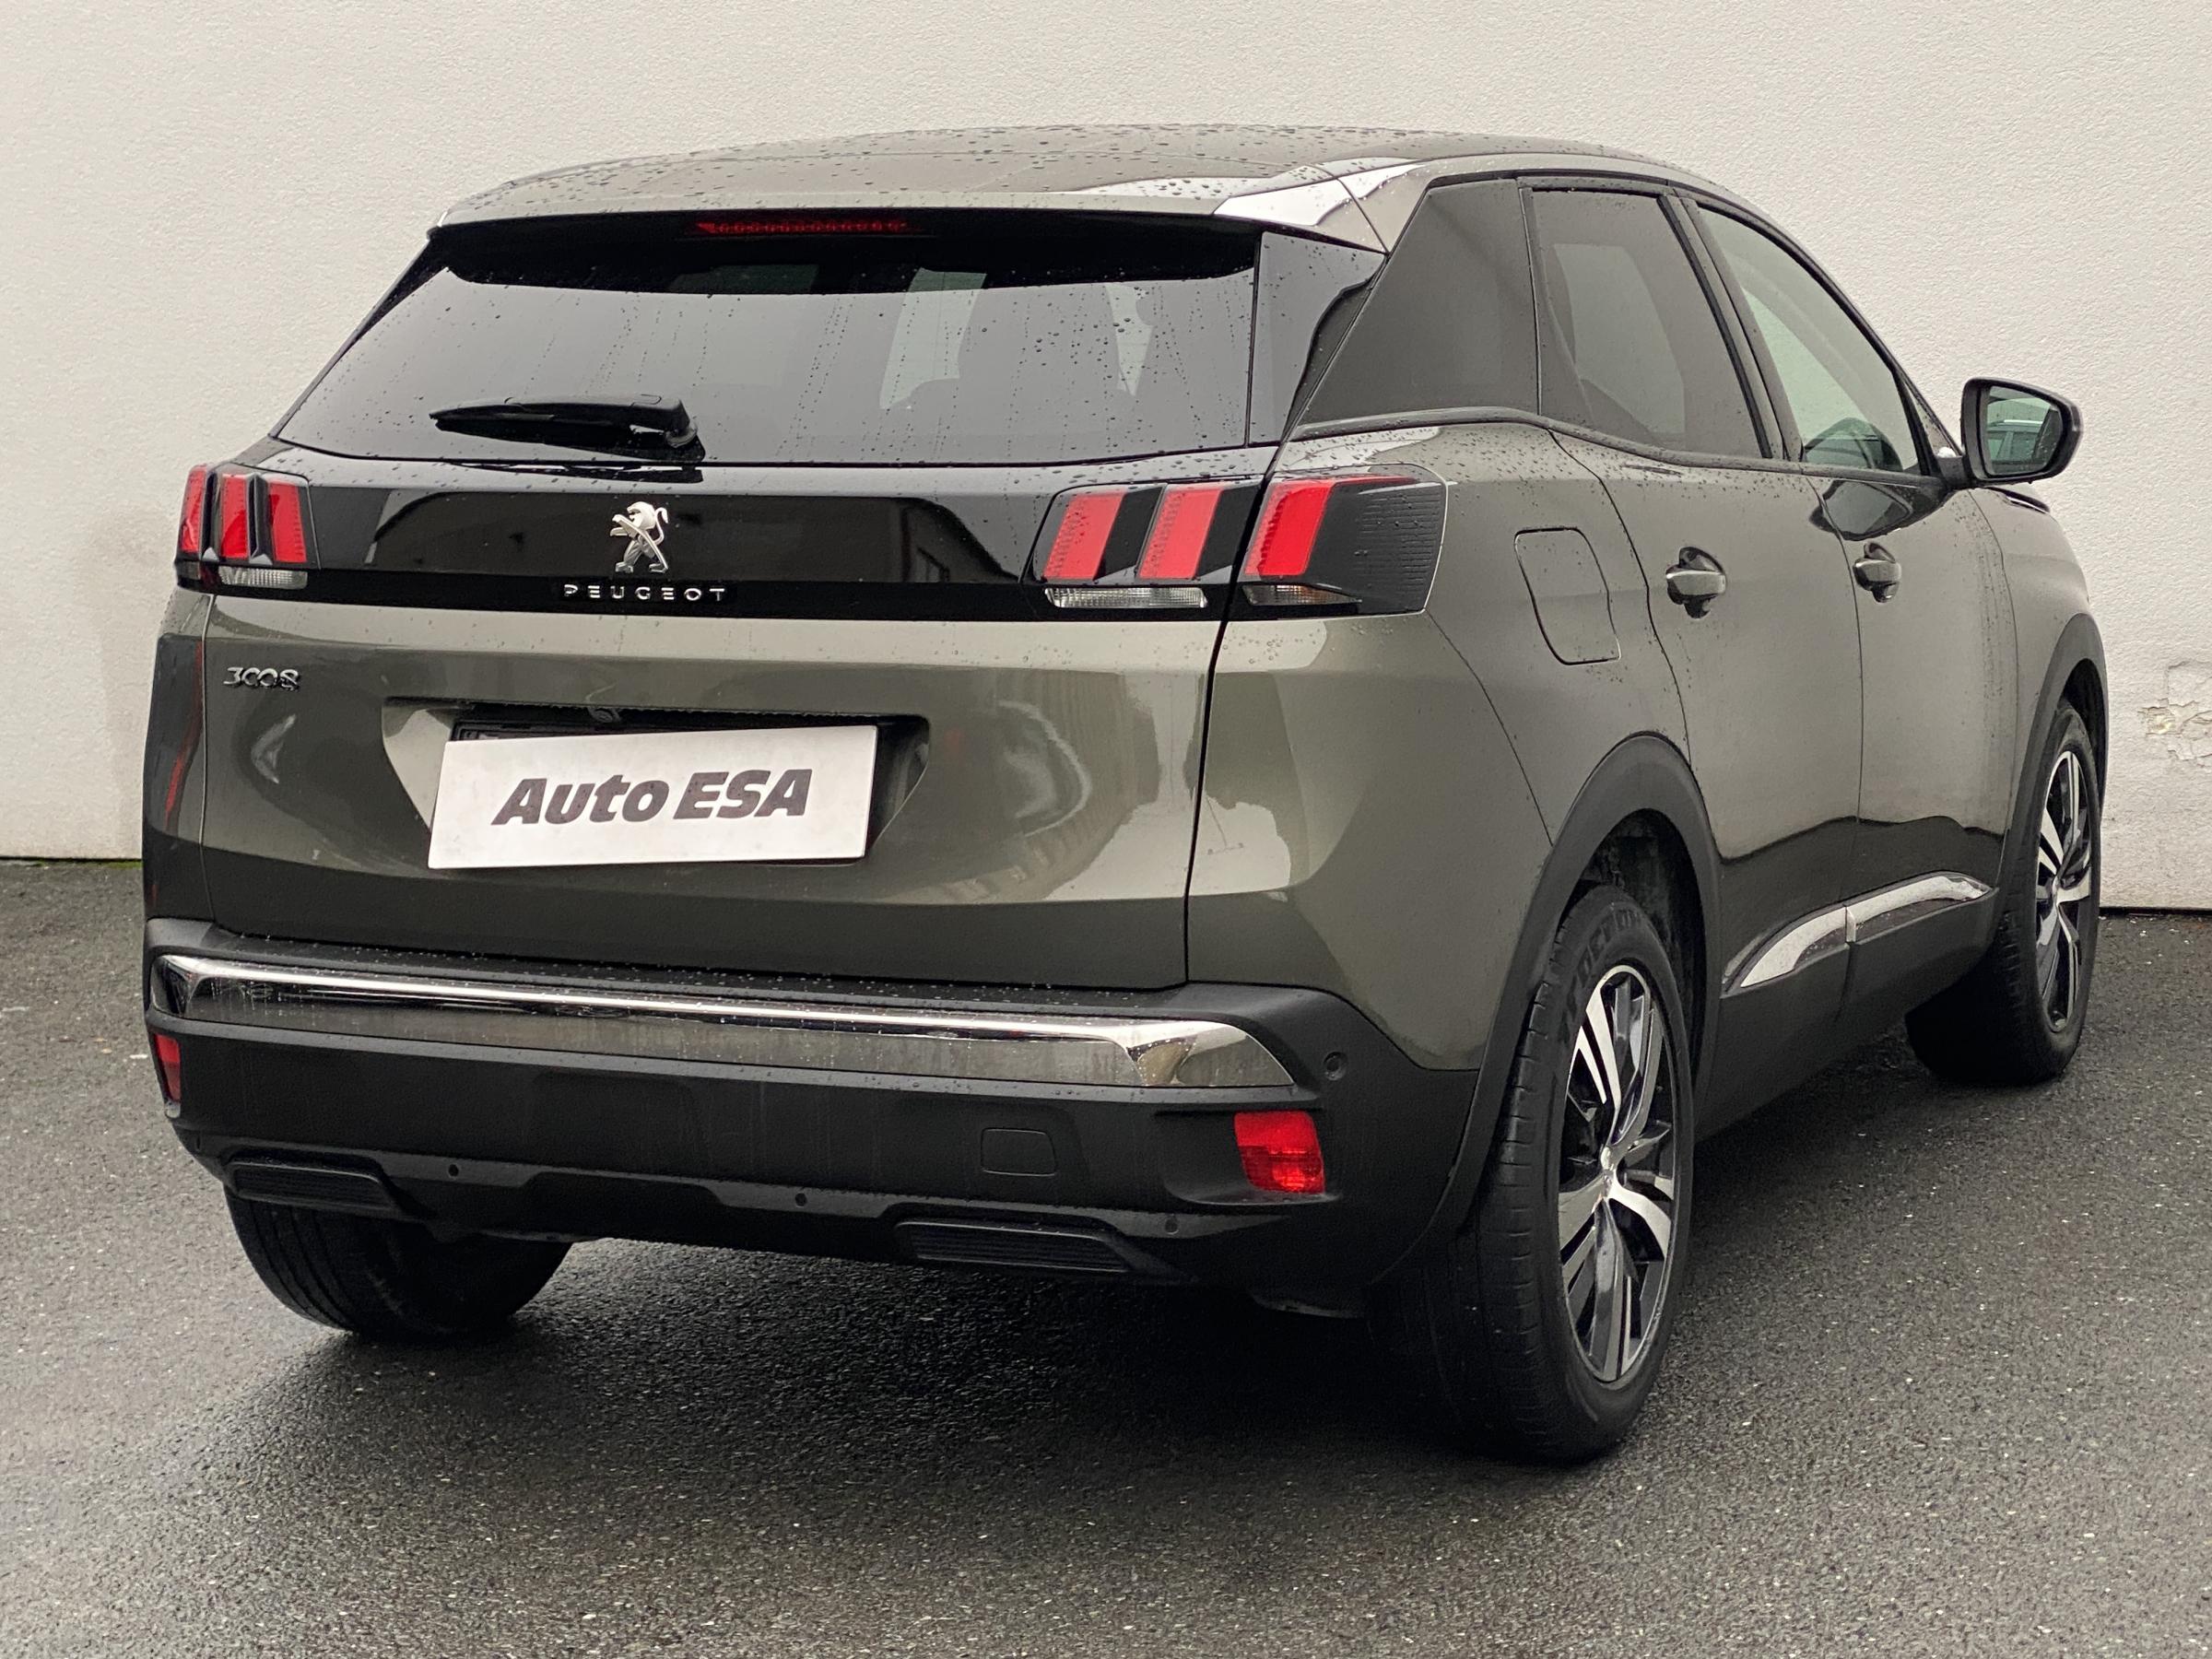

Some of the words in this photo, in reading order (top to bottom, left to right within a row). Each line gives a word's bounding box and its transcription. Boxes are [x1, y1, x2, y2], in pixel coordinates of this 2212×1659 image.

[563, 583, 725, 602] PEUGEOT
[222, 666, 300, 691] 3008
[490, 773, 670, 826] Auto
[672, 768, 813, 820] ESA
